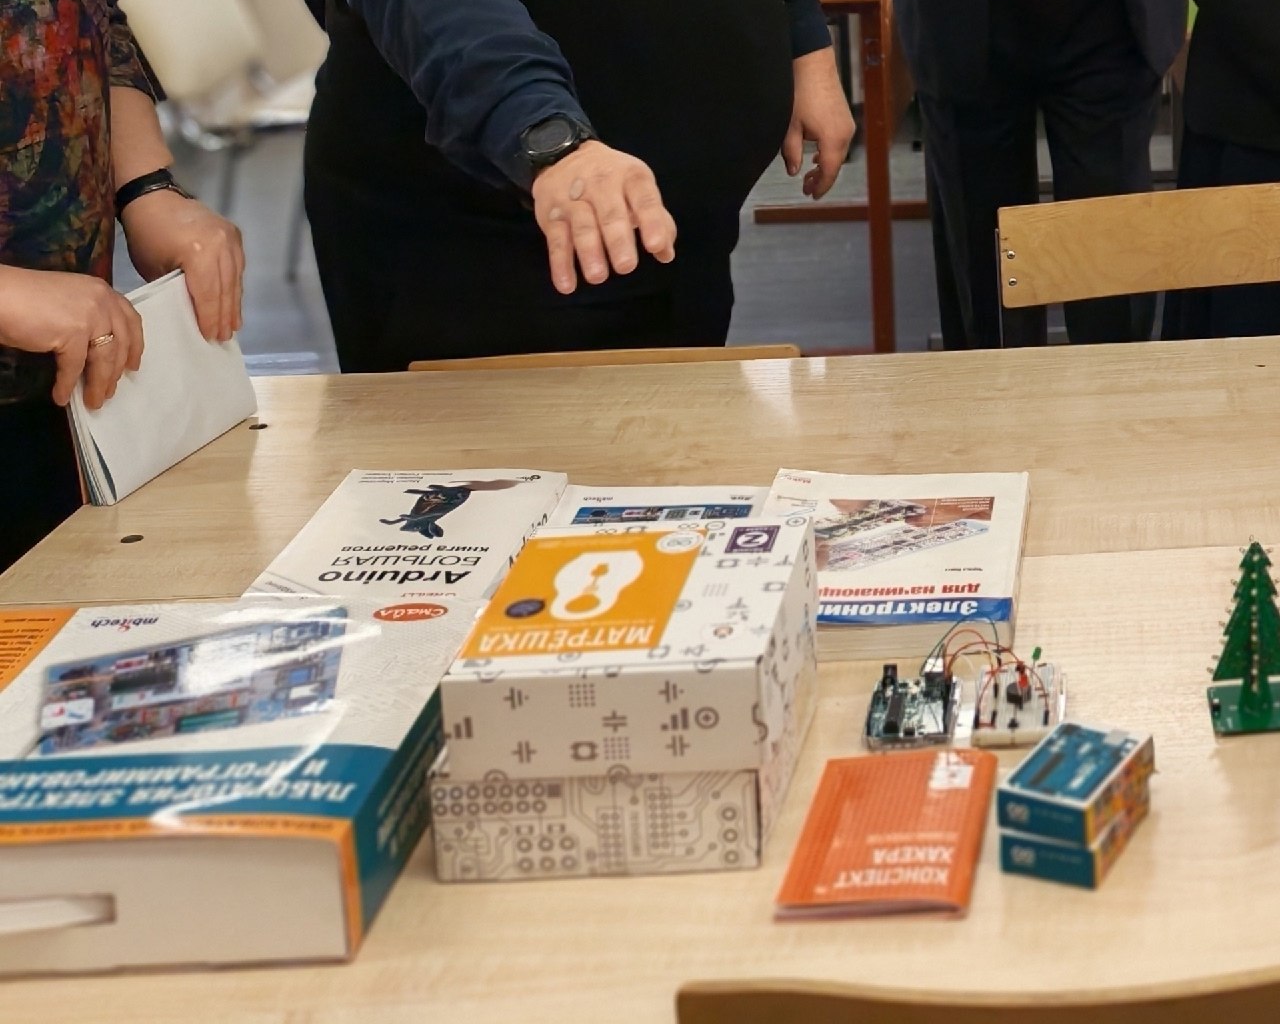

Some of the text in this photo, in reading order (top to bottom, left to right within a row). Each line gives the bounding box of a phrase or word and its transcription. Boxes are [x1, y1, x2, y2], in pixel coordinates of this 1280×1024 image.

[341, 544, 432, 553] рецептов
[331, 555, 482, 567] БОЛЬШАЯ
[318, 570, 472, 585] Arduino
[819, 582, 981, 597] для начинающ
[379, 607, 446, 621] Смайл
[90, 615, 160, 631] mbitech
[478, 625, 655, 653] МАТРЁШКА
[0, 787, 126, 809] ЭЛЕКТР
[873, 845, 955, 865] ХАКЕРА
[834, 866, 948, 888] КОНСПЕКТ
